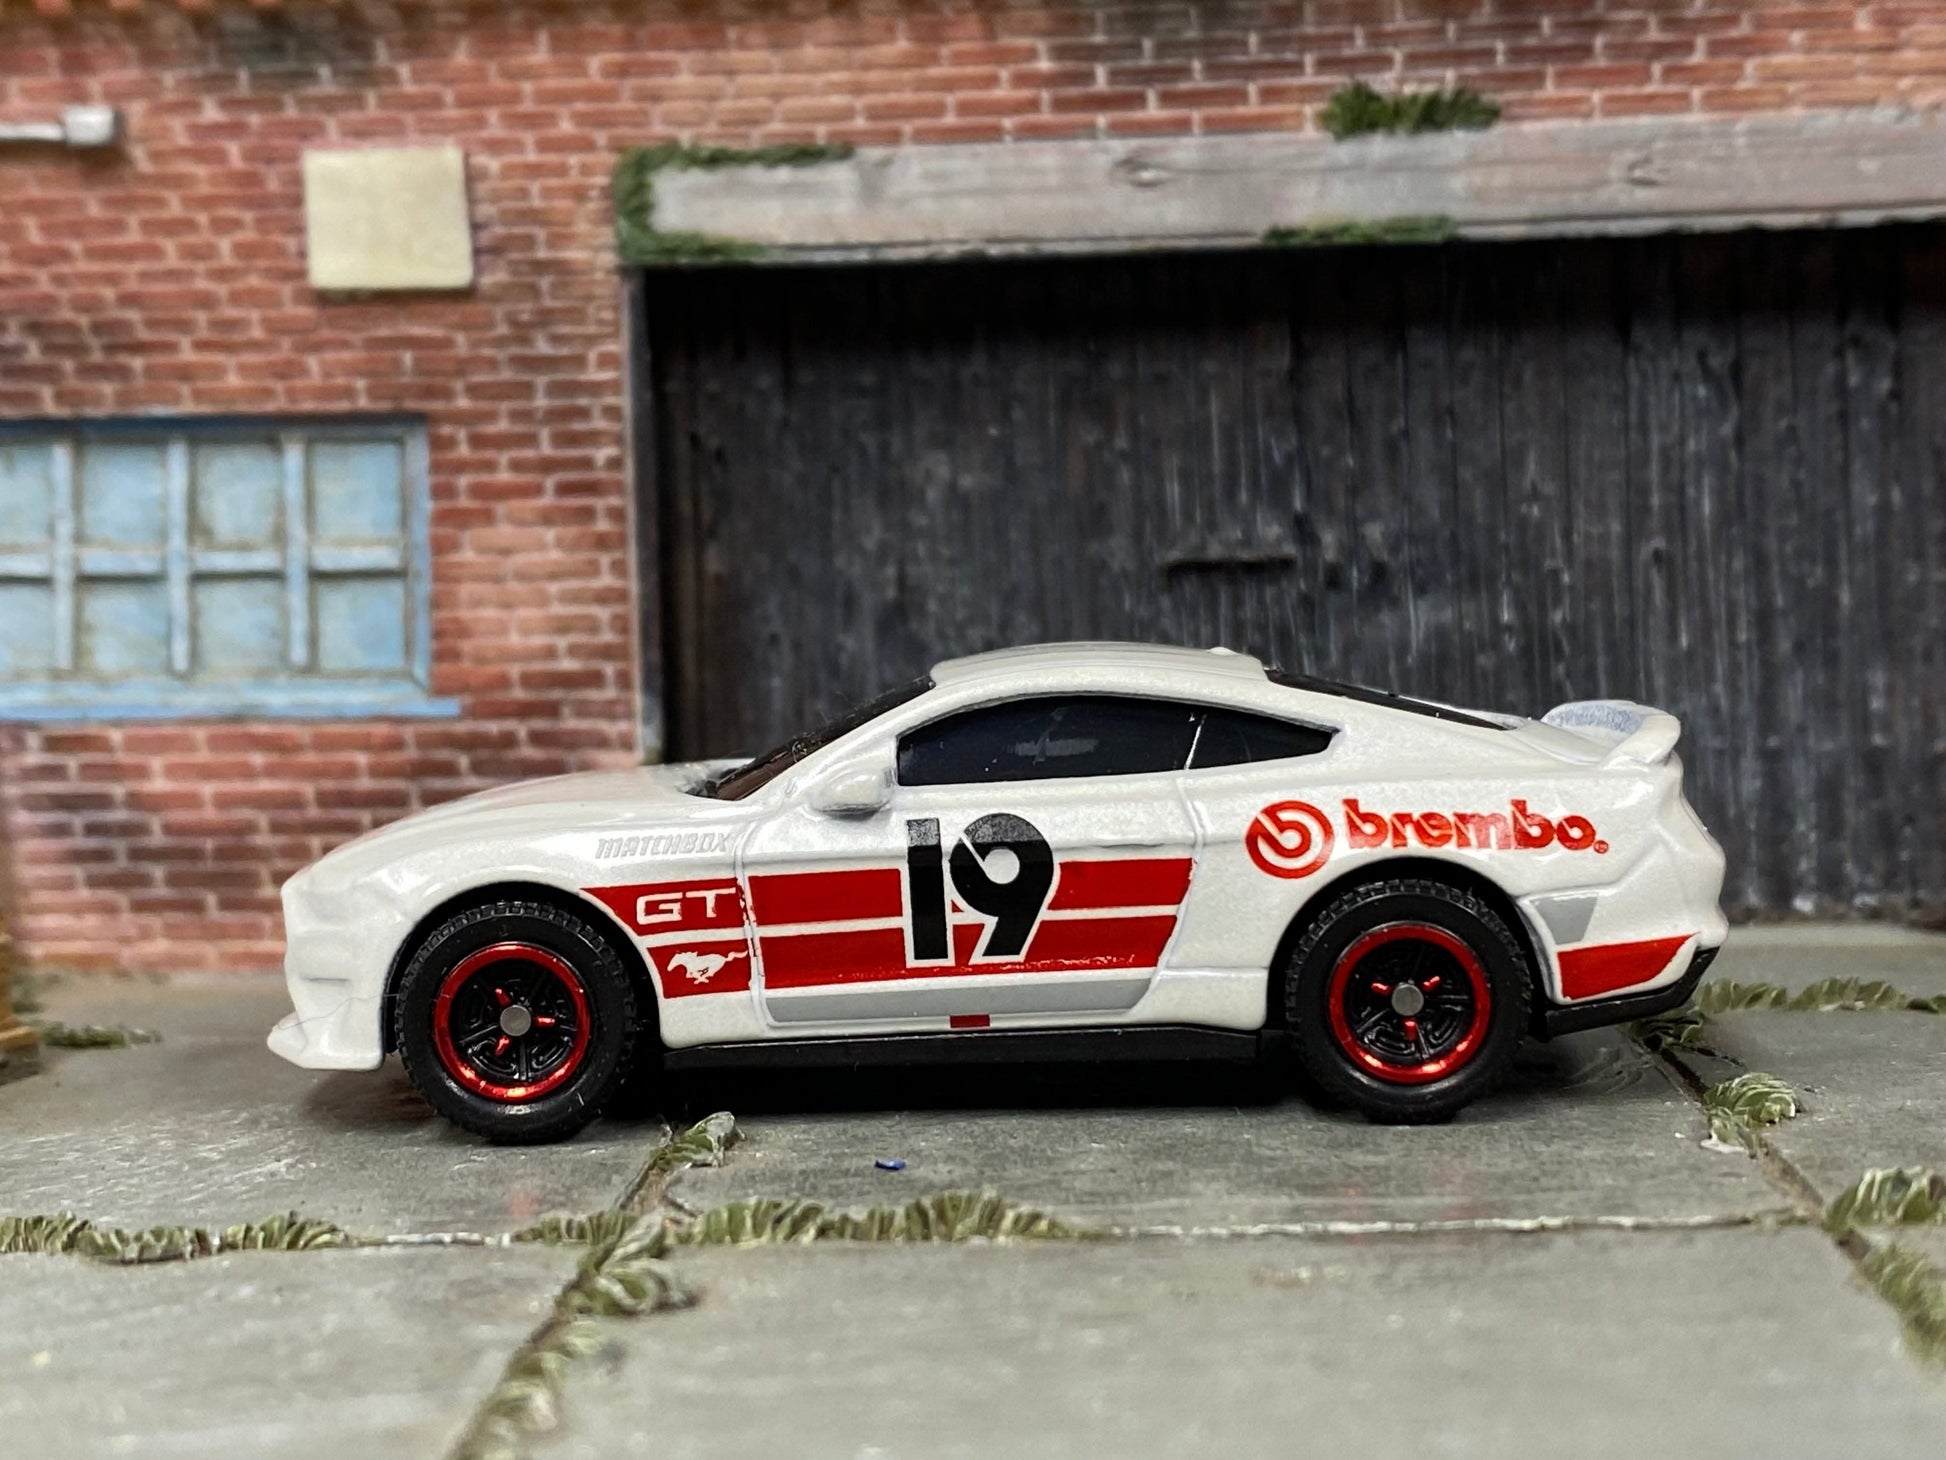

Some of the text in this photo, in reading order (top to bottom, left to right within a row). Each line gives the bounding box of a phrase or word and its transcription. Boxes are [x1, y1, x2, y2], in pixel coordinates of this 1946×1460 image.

[595, 832, 732, 860] MATCHBOX
[636, 886, 737, 926] GT
[905, 811, 1056, 961] 19
